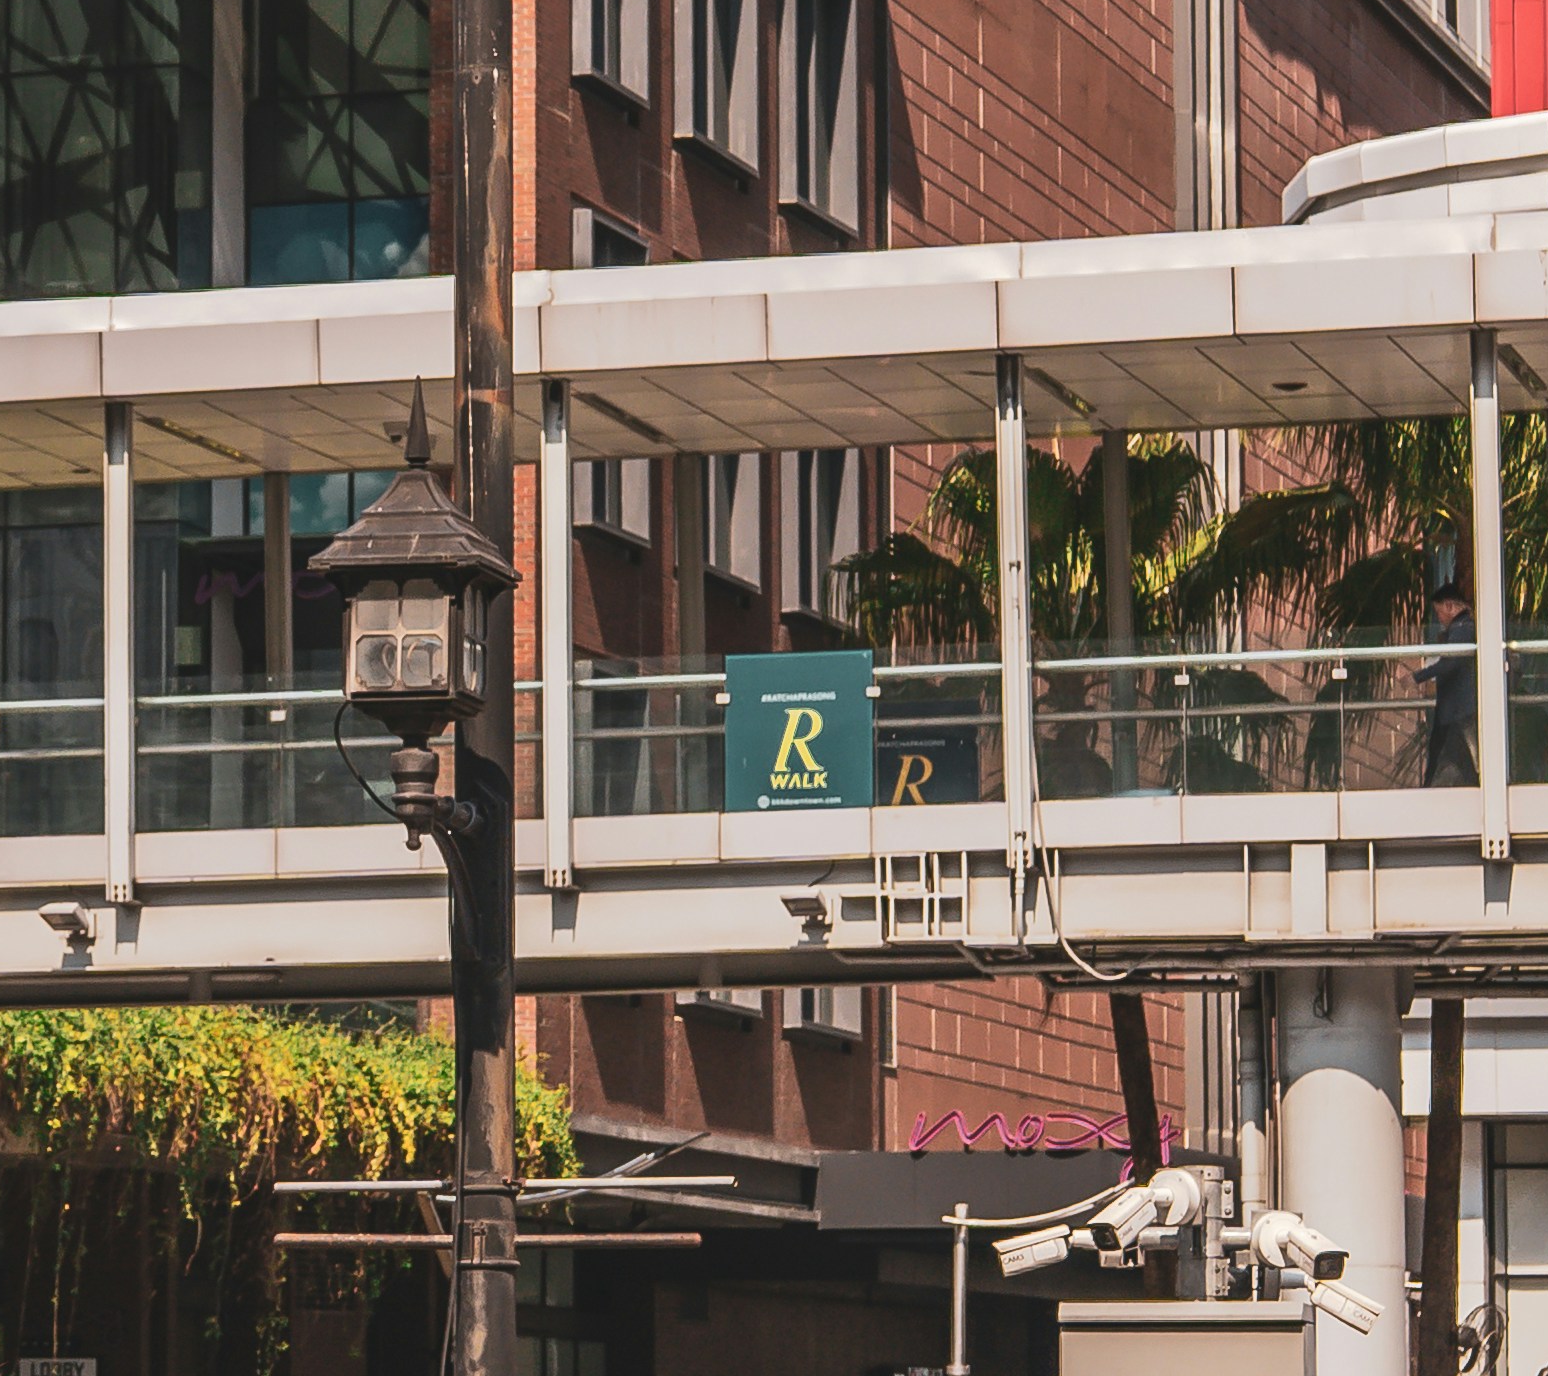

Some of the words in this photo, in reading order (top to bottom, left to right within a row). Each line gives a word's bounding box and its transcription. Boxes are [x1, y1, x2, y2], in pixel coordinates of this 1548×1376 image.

[774, 707, 825, 772] R
[769, 772, 828, 791] WALK
[891, 754, 933, 805] R
